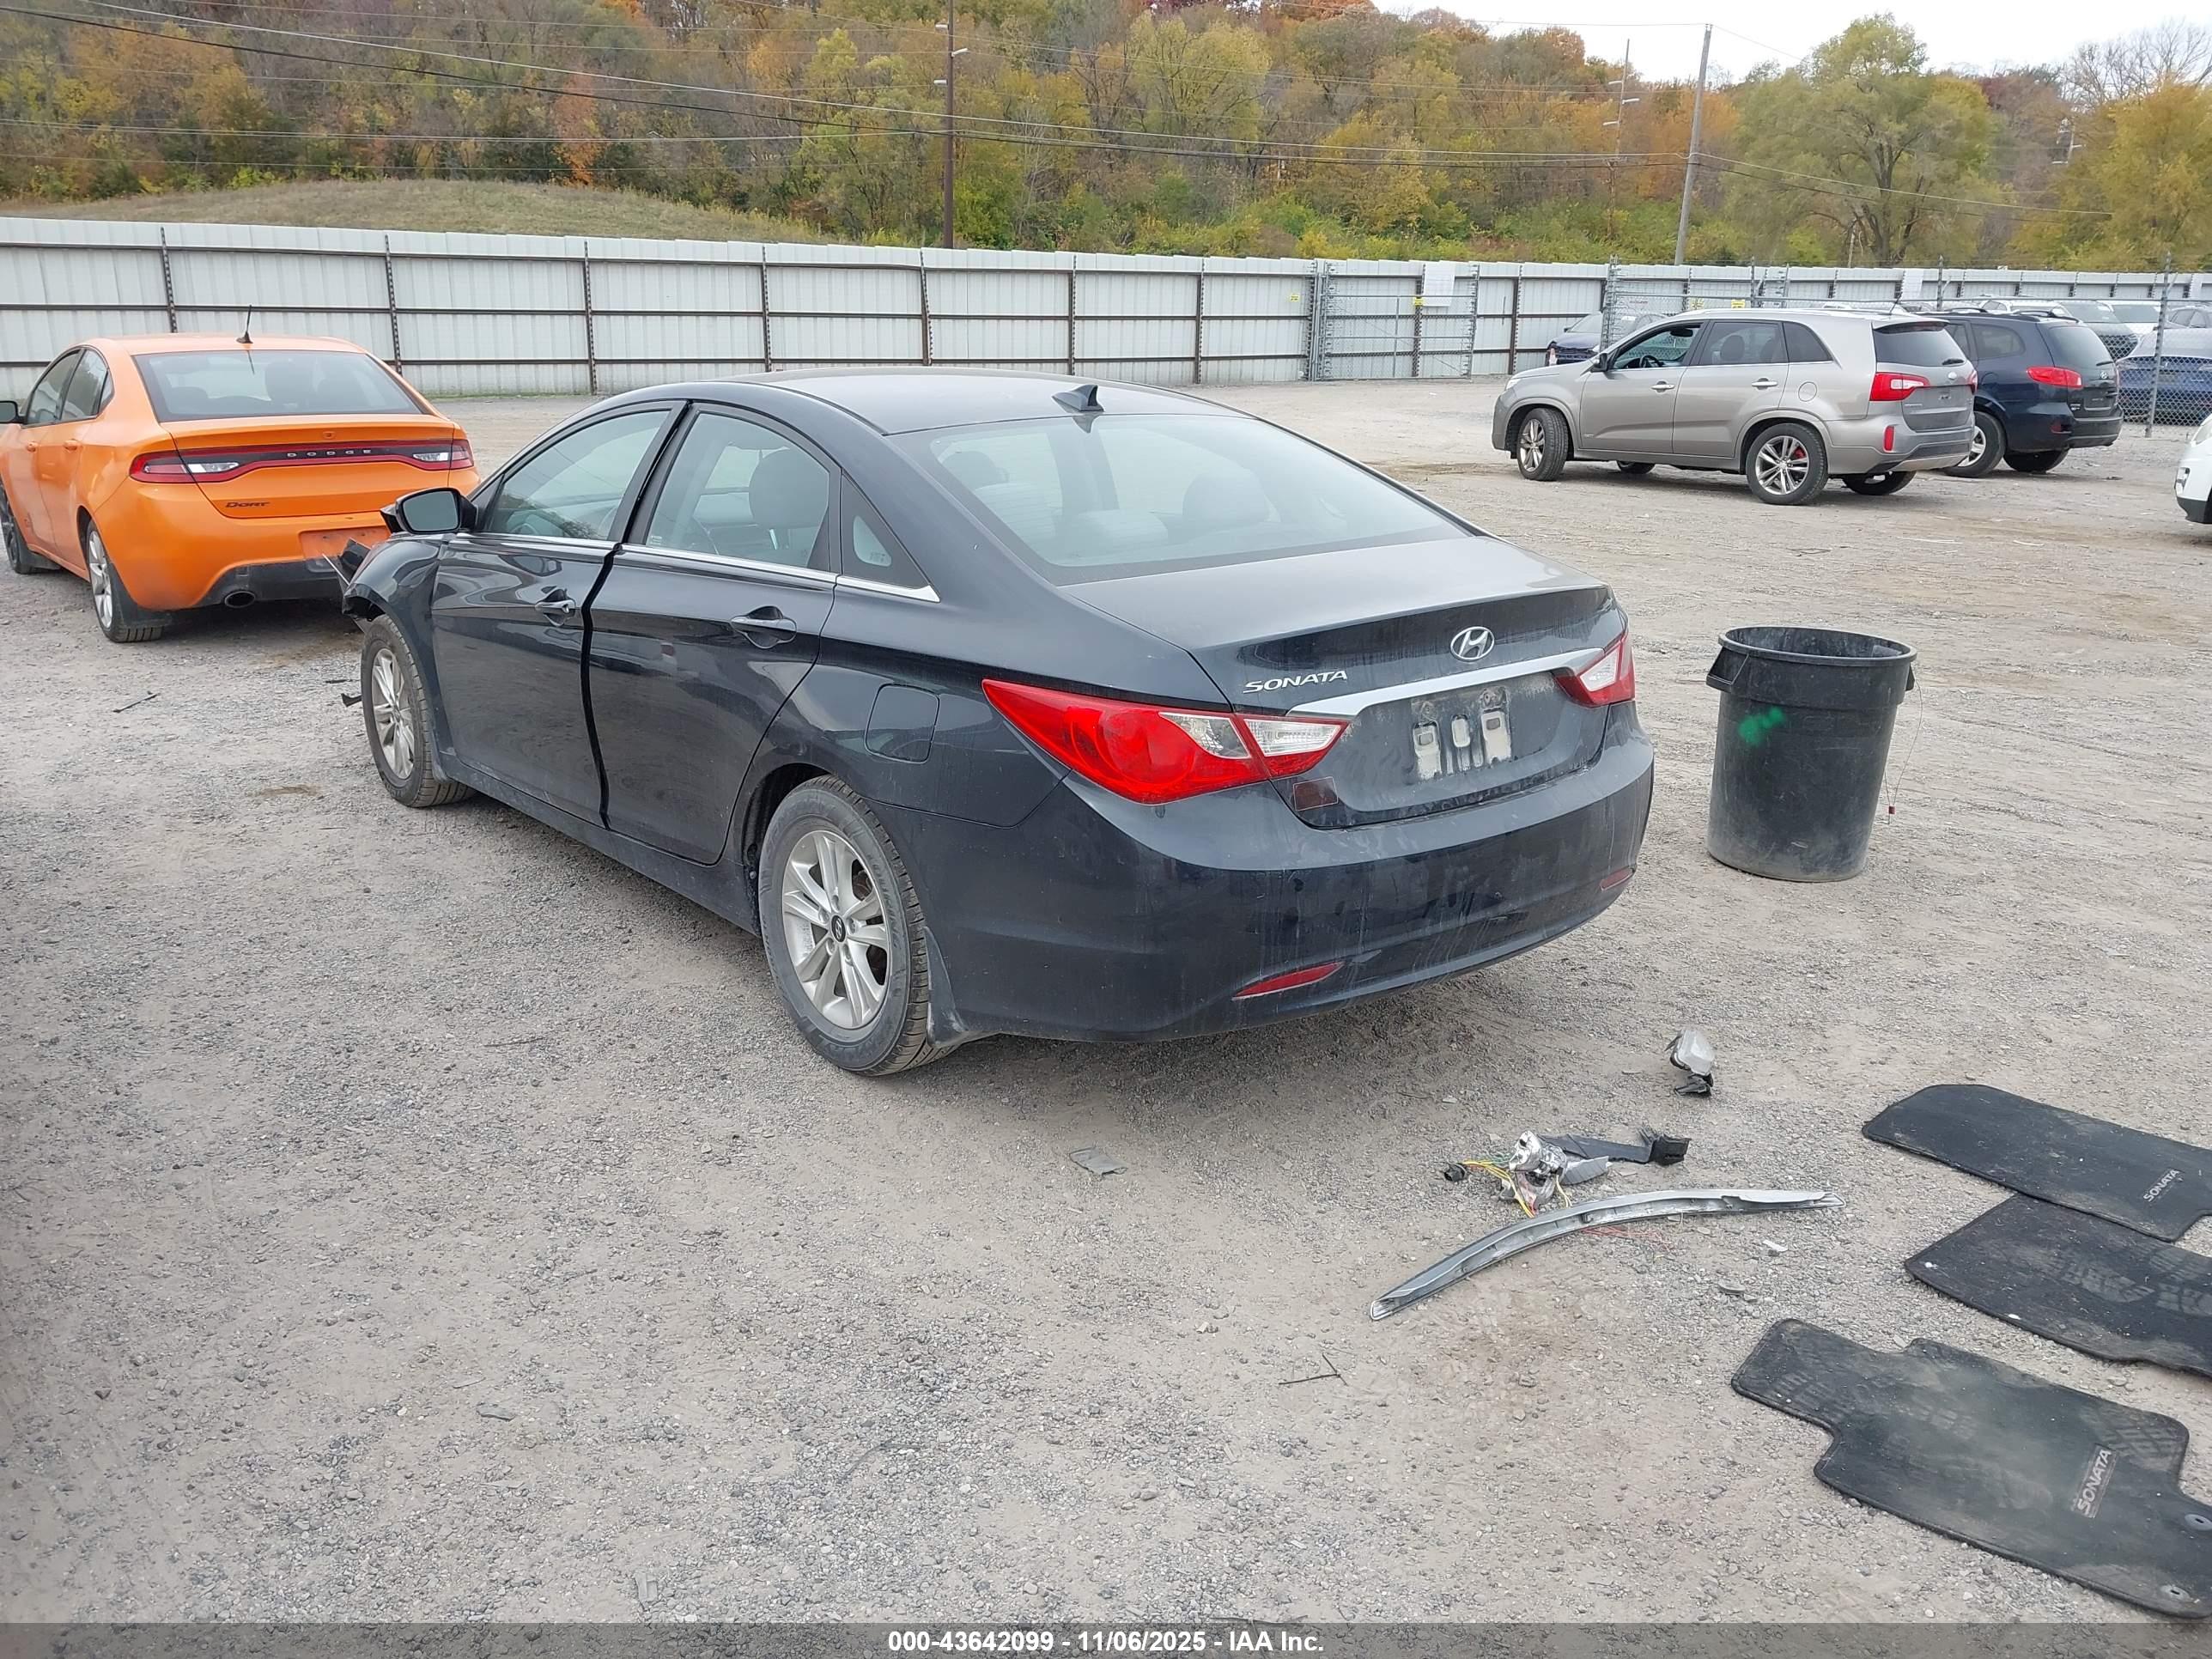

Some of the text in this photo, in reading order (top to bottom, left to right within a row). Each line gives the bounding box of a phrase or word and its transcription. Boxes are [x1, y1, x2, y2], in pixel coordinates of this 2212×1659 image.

[287, 449, 371, 458] DODGE
[1243, 670, 1348, 694] SONATA
[2143, 1170, 2179, 1202] SONATA
[2077, 1449, 2112, 1515] SONATA
